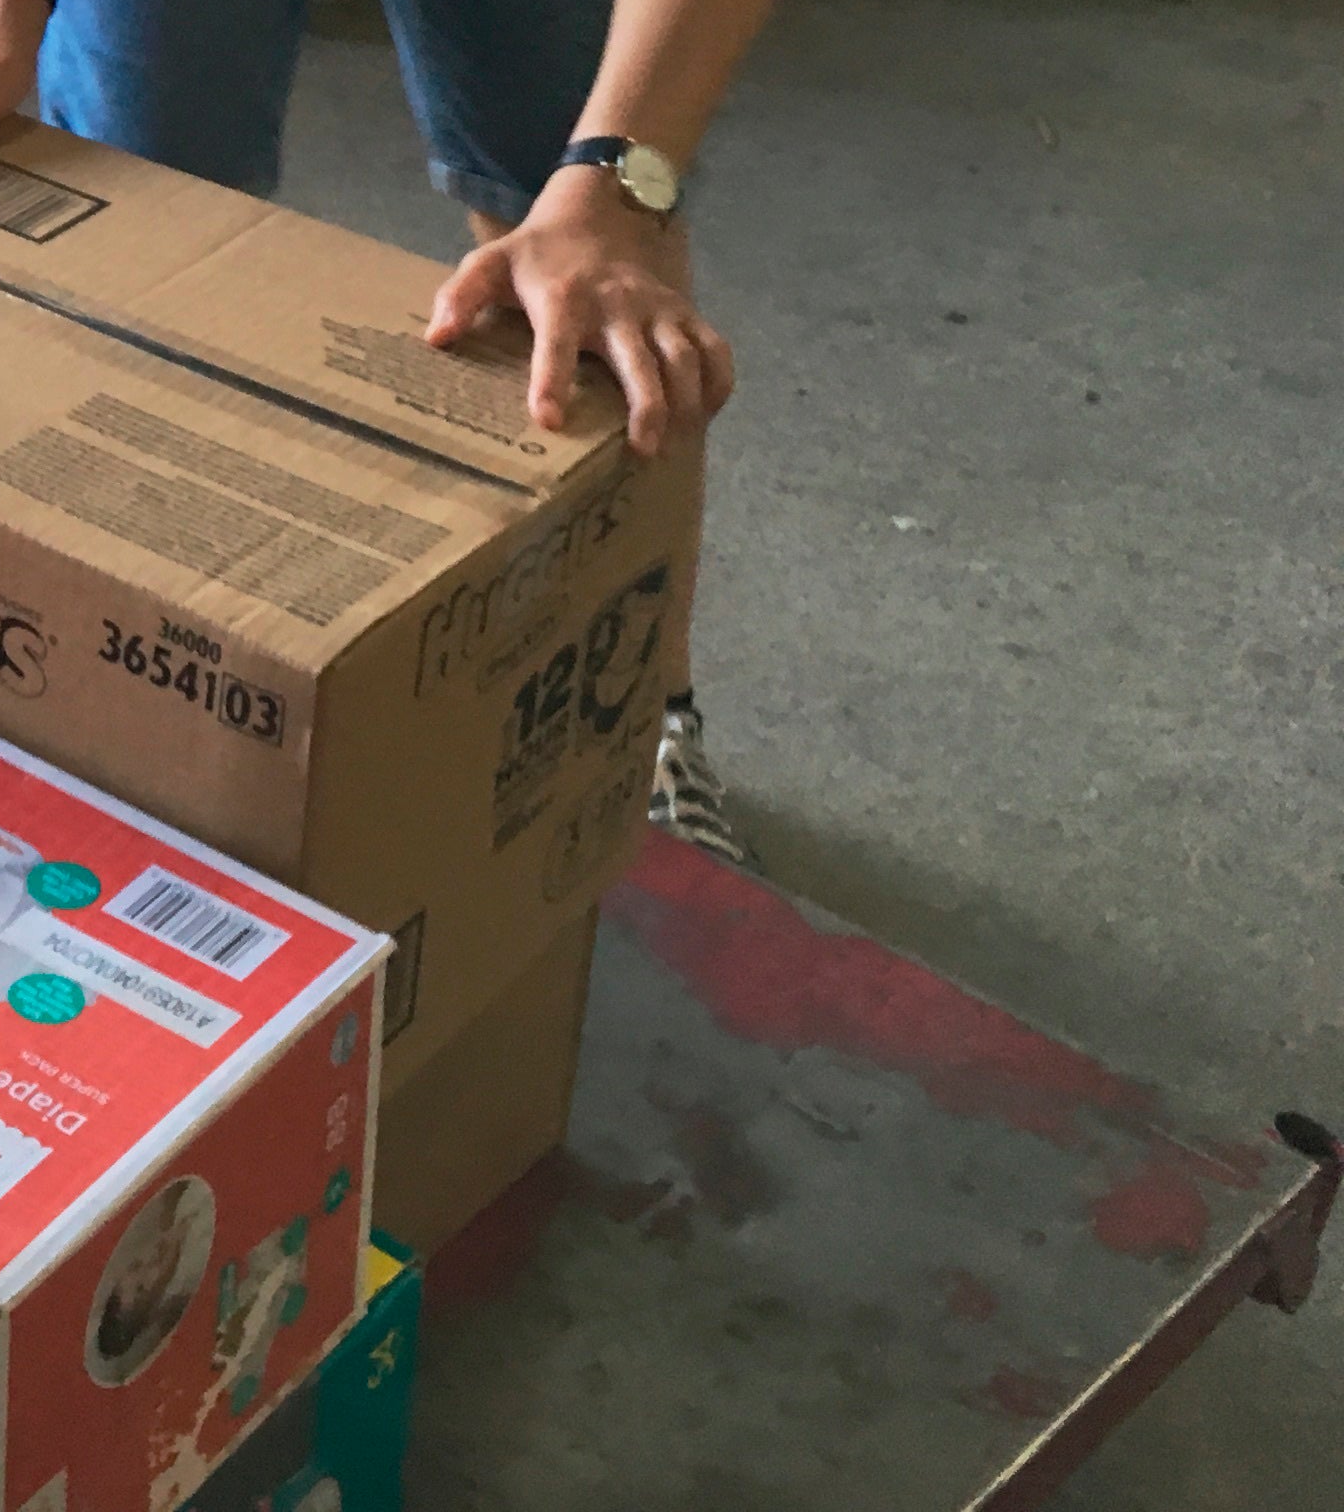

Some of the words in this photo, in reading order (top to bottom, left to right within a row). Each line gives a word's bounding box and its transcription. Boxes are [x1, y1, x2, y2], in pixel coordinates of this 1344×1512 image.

[157, 616, 224, 666] 36000
[19, 1048, 65, 1085] PACK
[66, 1068, 112, 1107] SUPER
